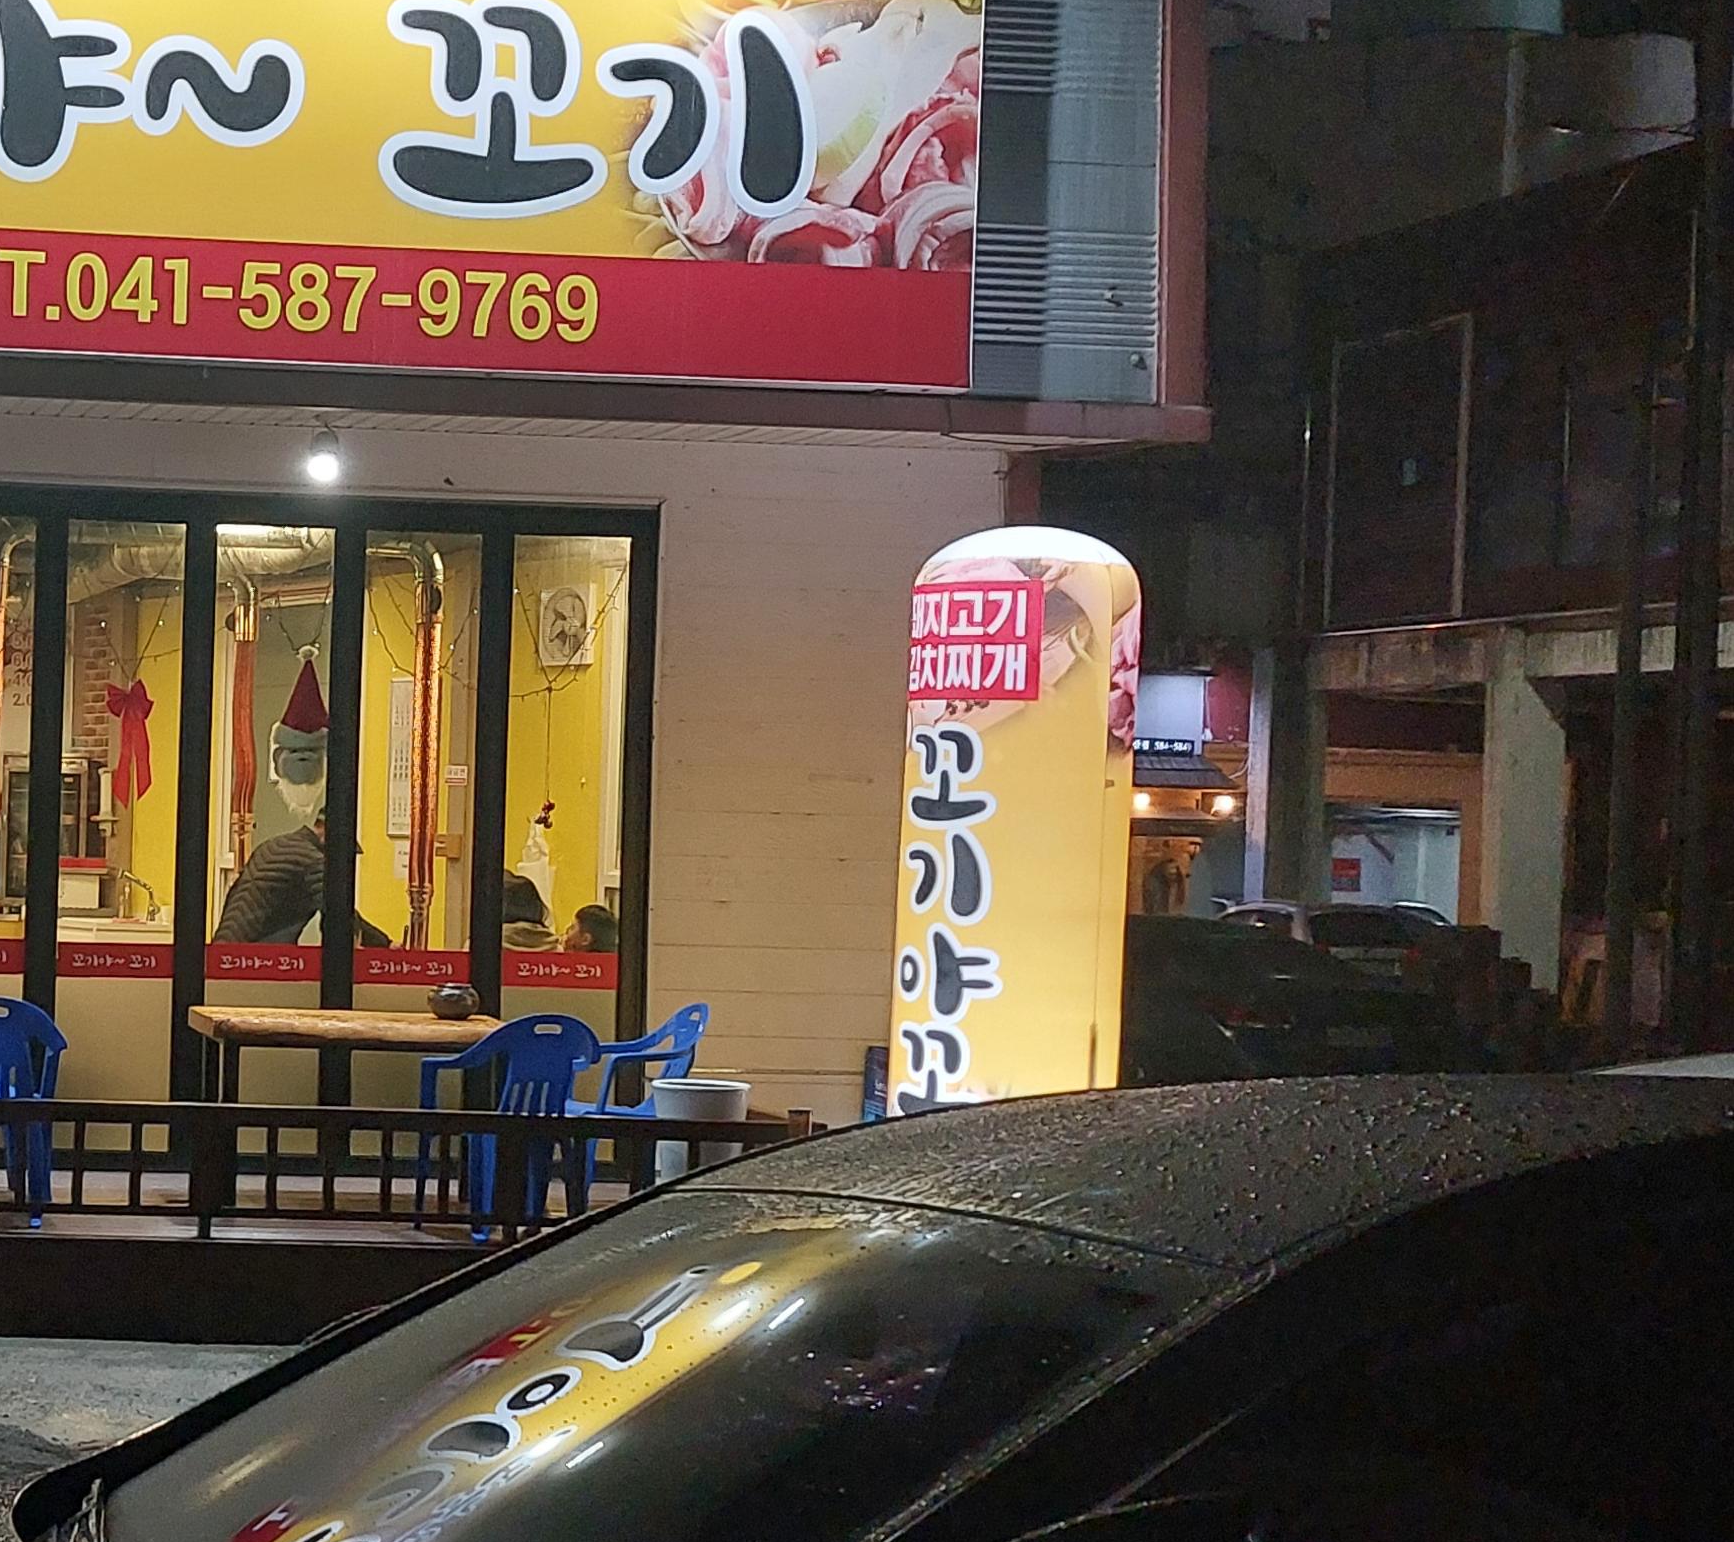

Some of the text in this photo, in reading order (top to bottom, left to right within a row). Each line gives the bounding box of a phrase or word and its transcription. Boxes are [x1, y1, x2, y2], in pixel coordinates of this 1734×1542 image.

[390, 3, 807, 207] 꼬기
[129, 954, 157, 969] 꼬기
[278, 956, 304, 971] 꼬기
[425, 960, 453, 976] 꼬기
[574, 963, 602, 978] 꼬기
